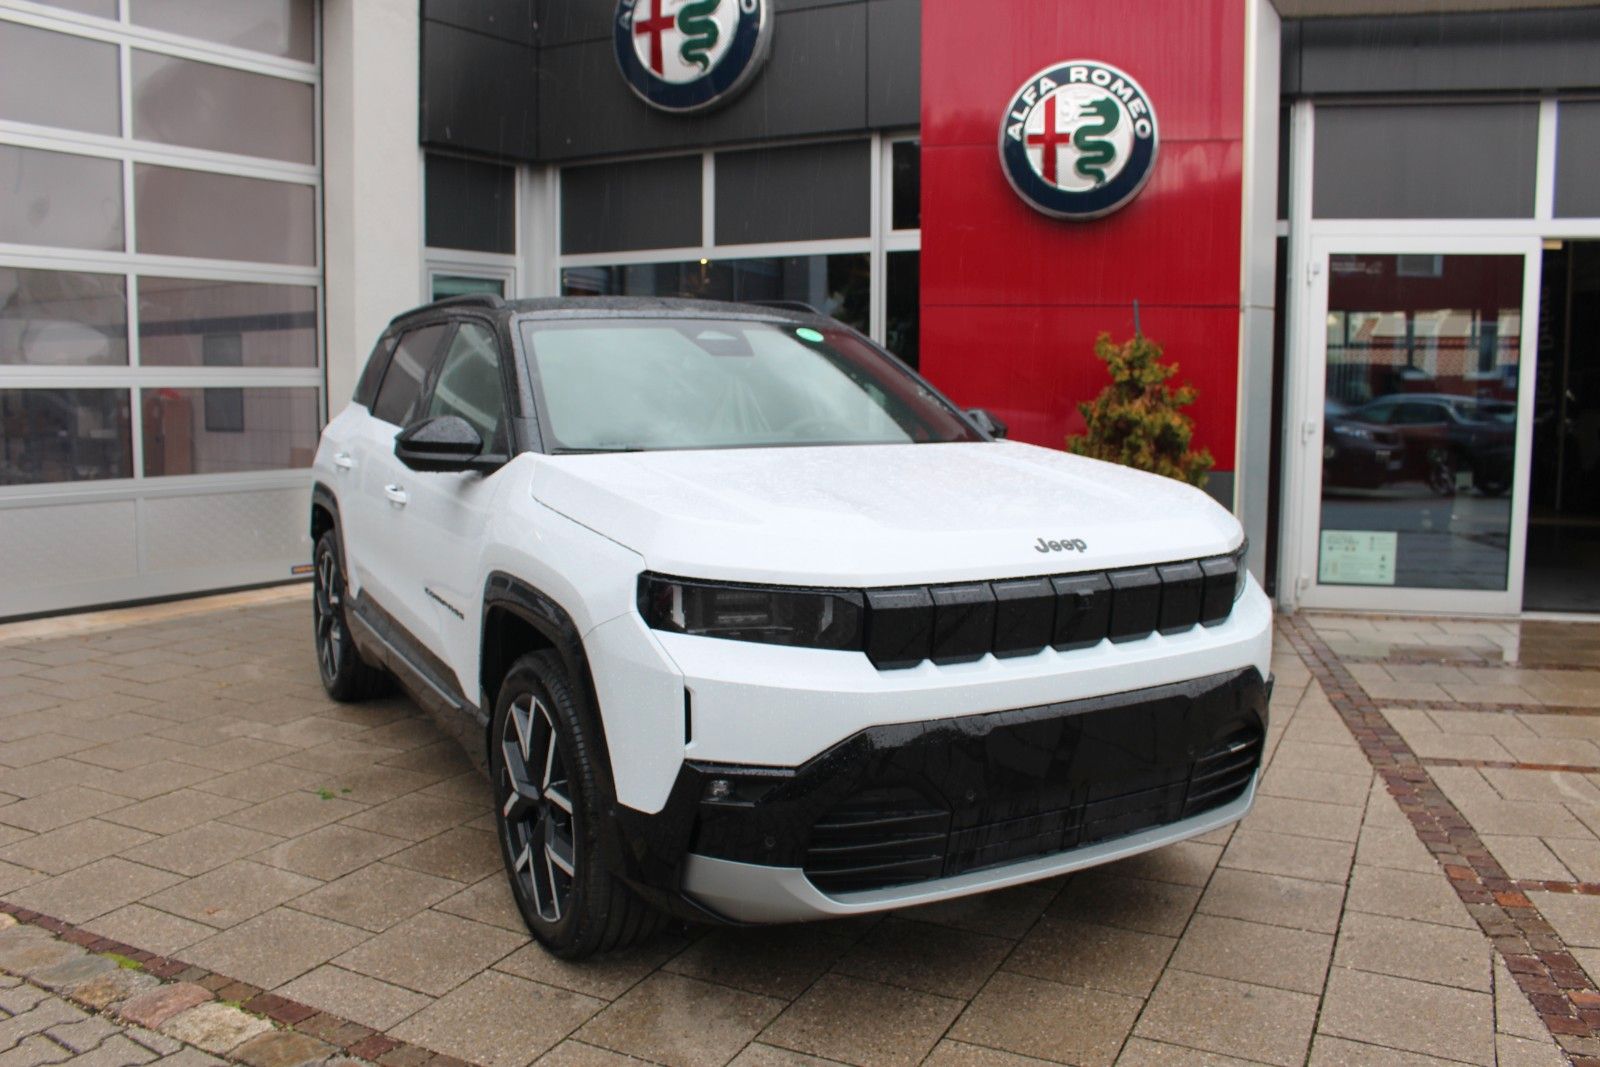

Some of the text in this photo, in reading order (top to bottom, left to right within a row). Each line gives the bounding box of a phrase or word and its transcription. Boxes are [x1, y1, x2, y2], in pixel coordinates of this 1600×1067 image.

[1007, 66, 1152, 142] ALFA ROMEO
[1034, 537, 1087, 553] Jeep
